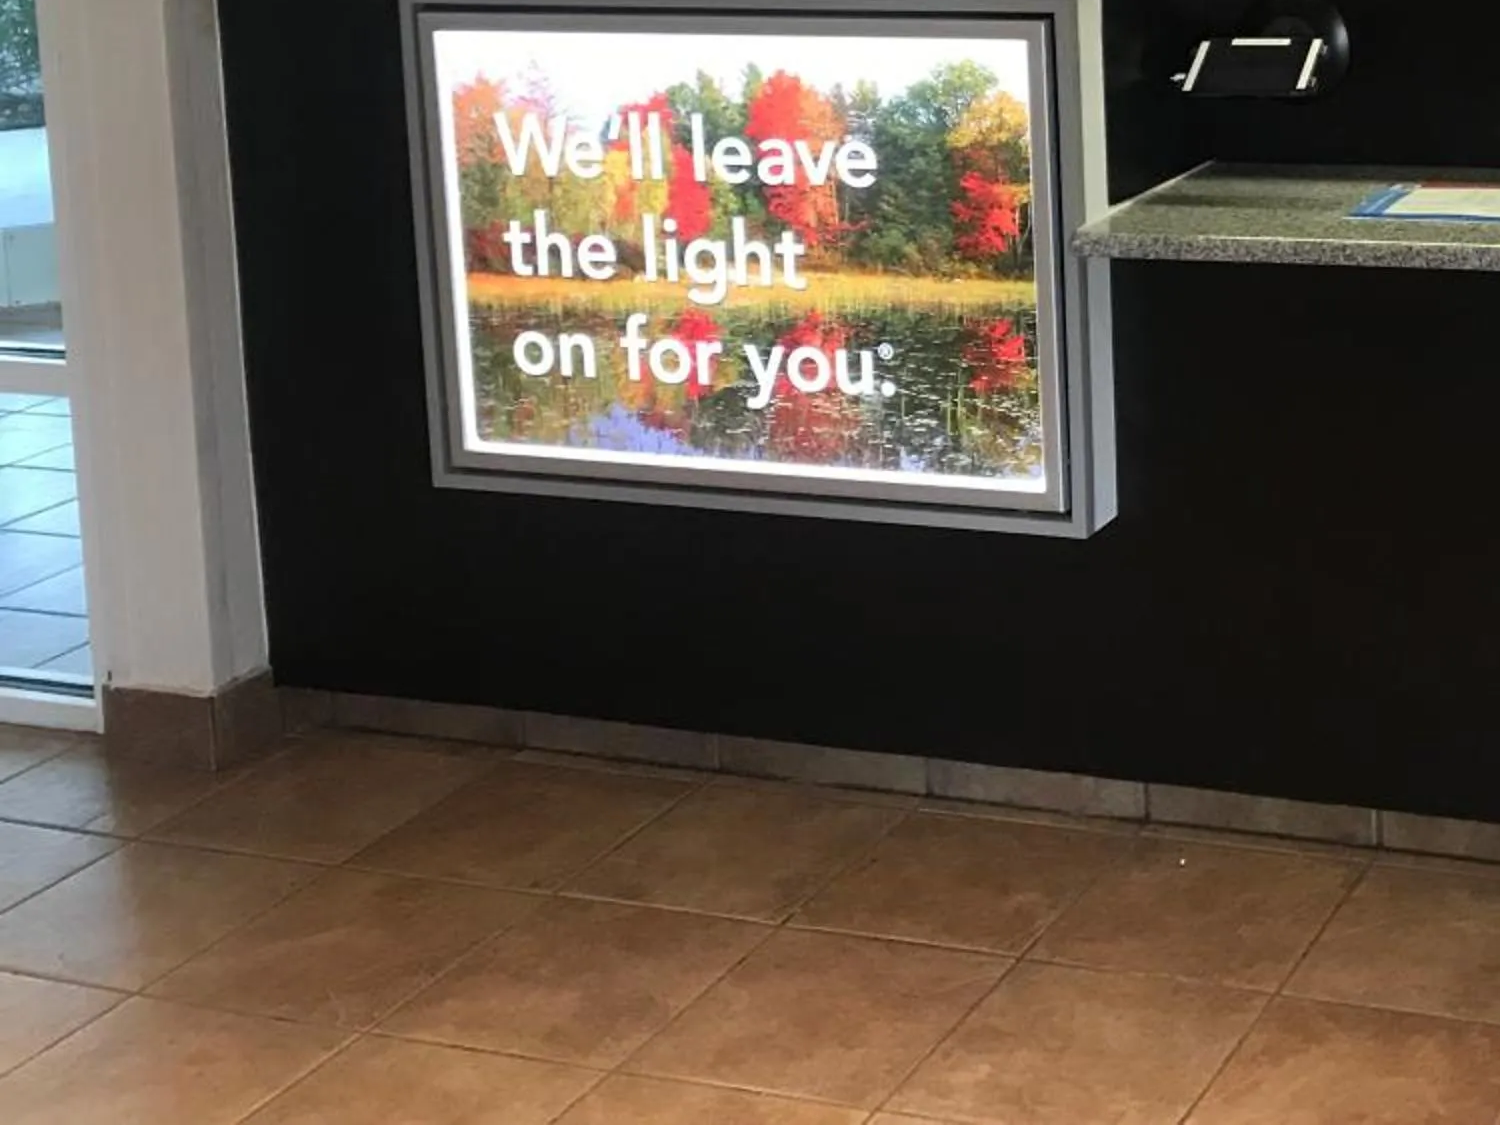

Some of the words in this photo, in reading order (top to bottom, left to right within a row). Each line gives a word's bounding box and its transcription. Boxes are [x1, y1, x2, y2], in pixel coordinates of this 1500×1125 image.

[492, 110, 663, 180] We'll
[691, 112, 878, 188] leave
[503, 209, 617, 279] the
[642, 212, 807, 304] light
[513, 330, 597, 378] on
[620, 313, 723, 385] for
